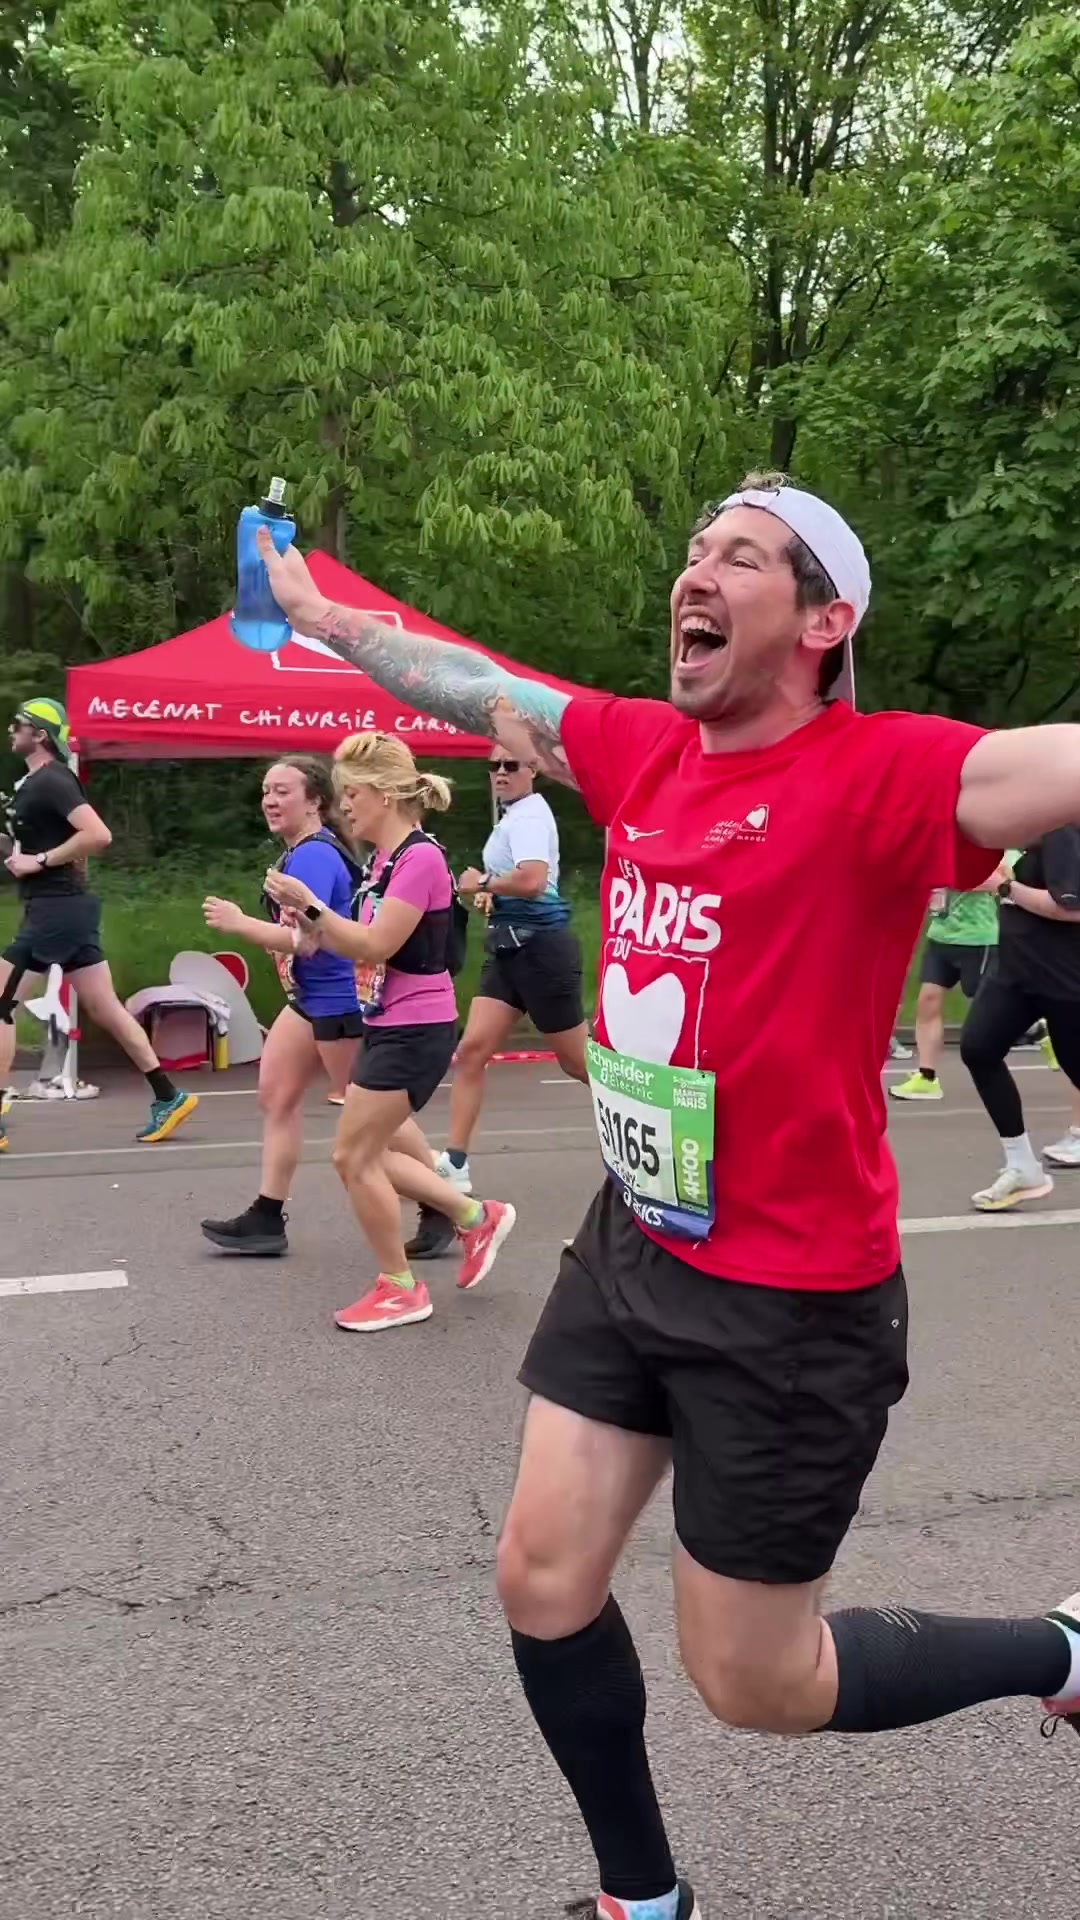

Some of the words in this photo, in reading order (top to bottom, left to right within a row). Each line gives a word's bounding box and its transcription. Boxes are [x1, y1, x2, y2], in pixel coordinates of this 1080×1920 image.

[88, 696, 222, 720] MECENAT
[618, 857, 634, 880] LE
[612, 936, 633, 961] DU
[588, 1042, 655, 1086] Schneider
[610, 1074, 653, 1100] Electric
[597, 1097, 660, 1177] 51165
[681, 1138, 700, 1199] 4H00
